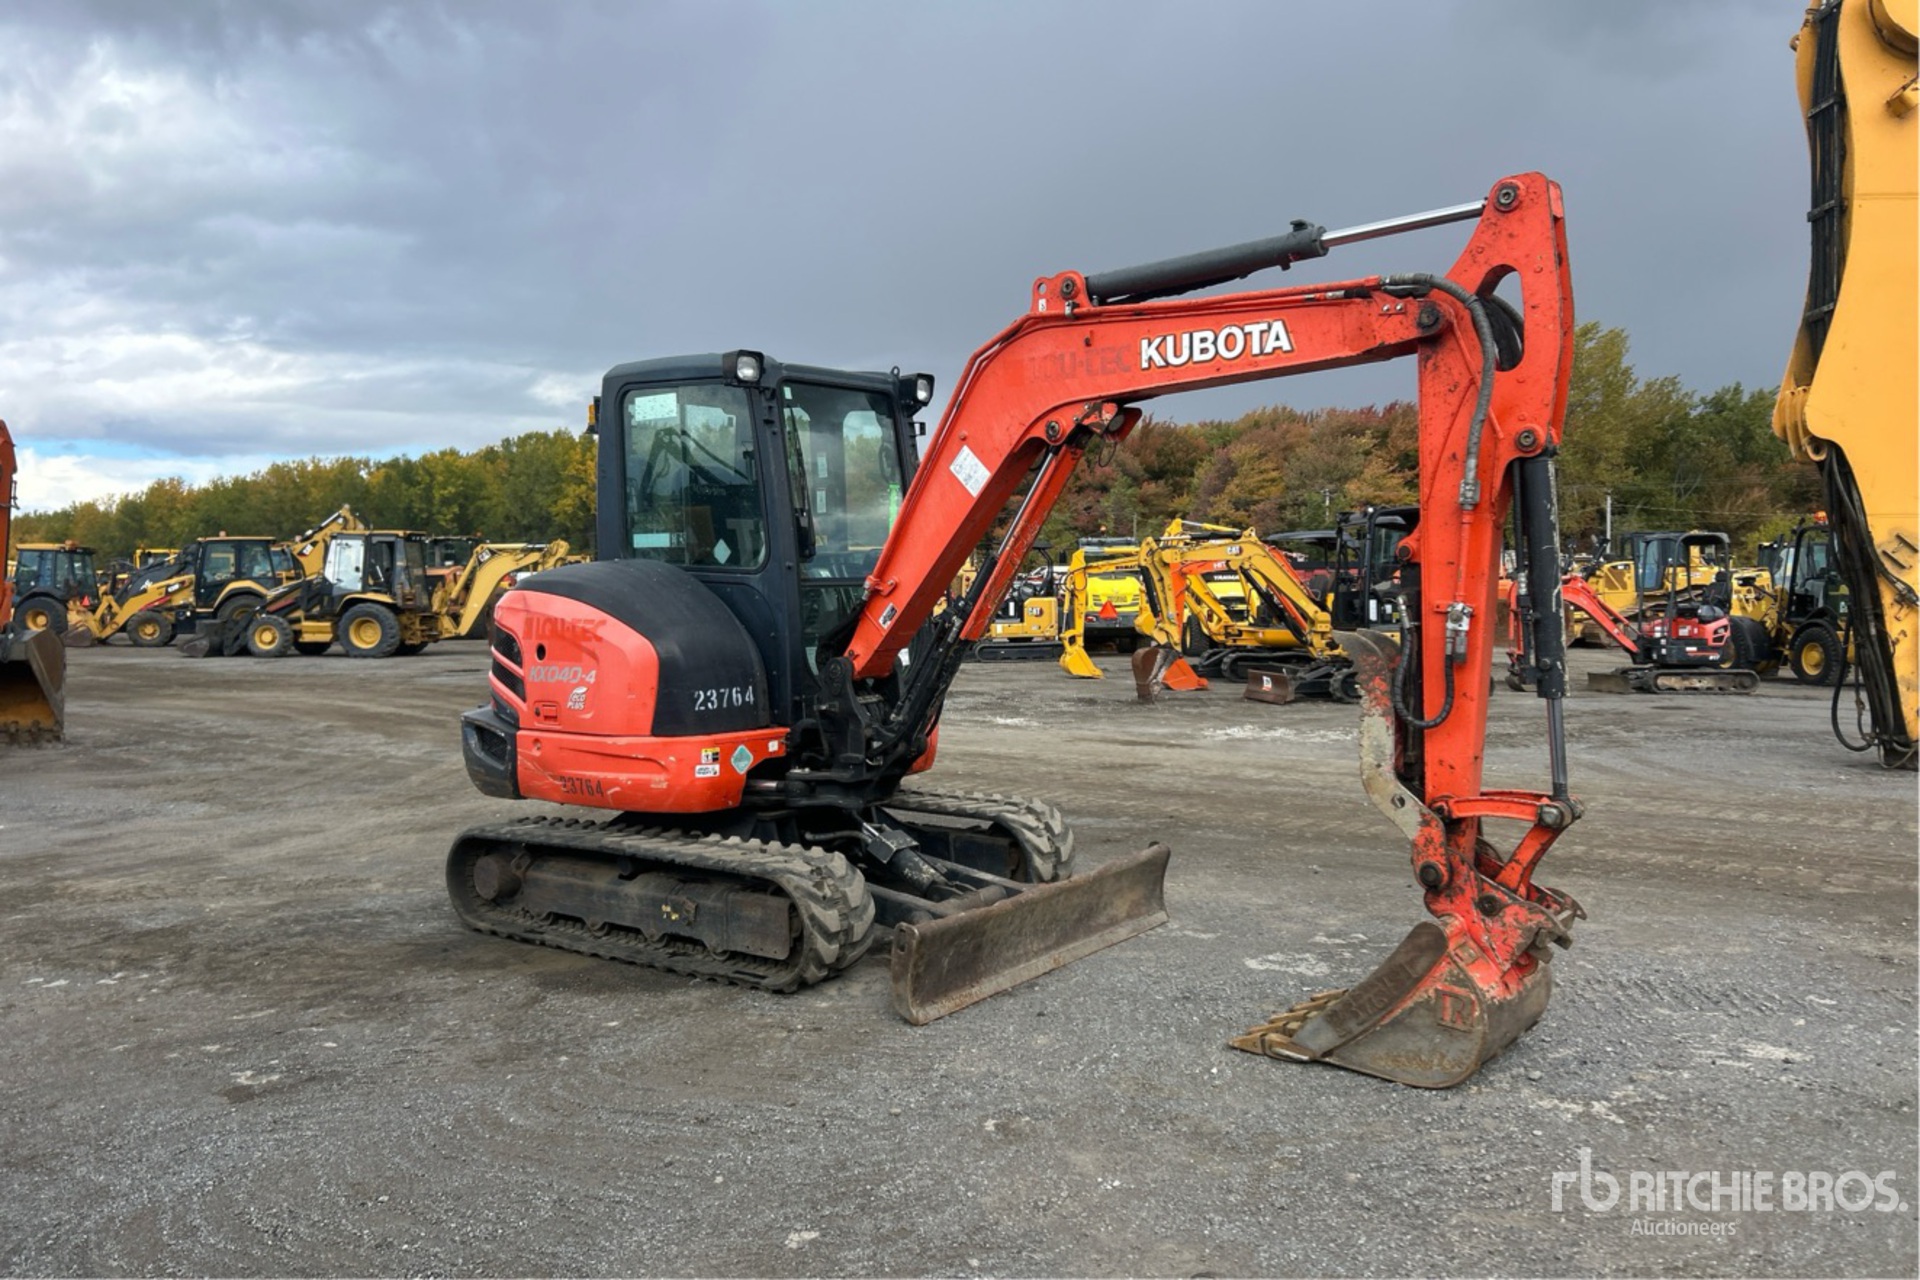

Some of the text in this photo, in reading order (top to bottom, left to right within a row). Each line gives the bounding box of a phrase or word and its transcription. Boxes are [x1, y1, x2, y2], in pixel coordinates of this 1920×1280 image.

[1139, 319, 1293, 370] KUBOTA
[693, 685, 755, 711] 23764
[560, 776, 605, 797] 23764
